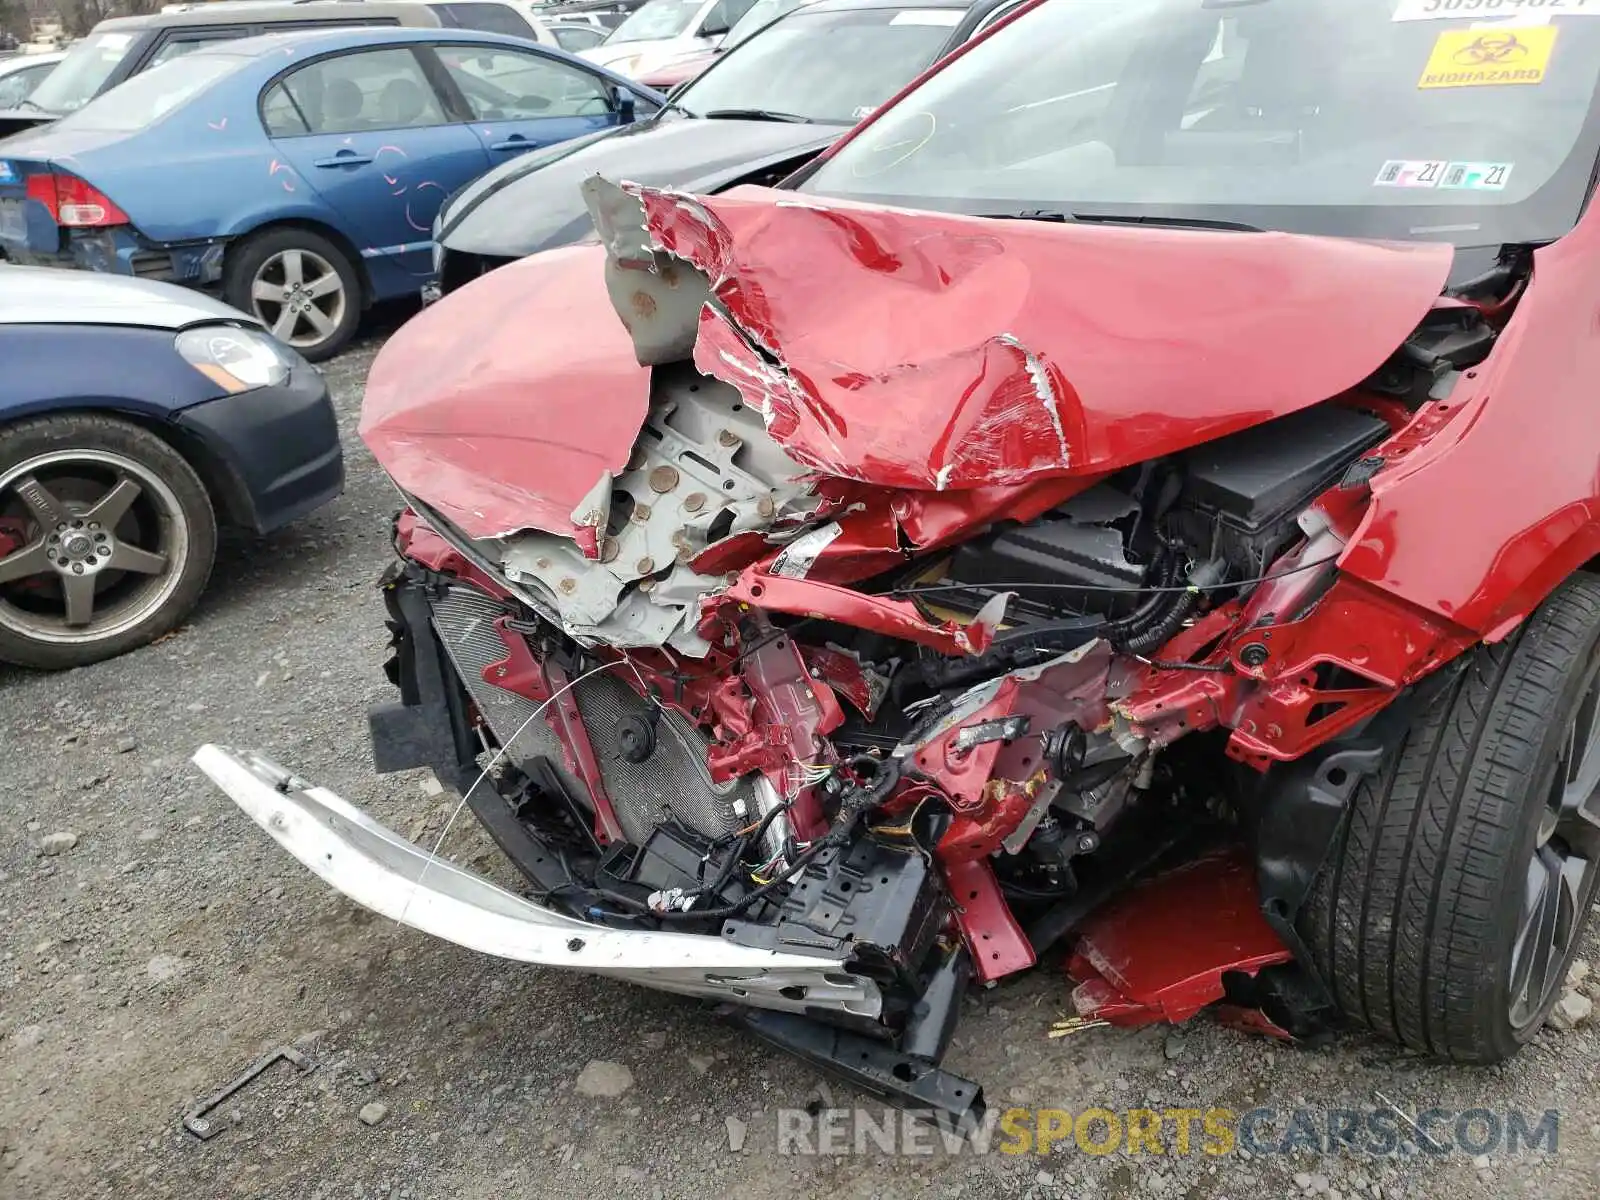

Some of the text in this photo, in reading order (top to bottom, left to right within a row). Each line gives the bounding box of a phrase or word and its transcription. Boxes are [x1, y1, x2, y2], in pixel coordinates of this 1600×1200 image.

[1425, 69, 1541, 83] BIOHAZARD
[1417, 163, 1440, 182] 21
[1484, 166, 1507, 185] 21
